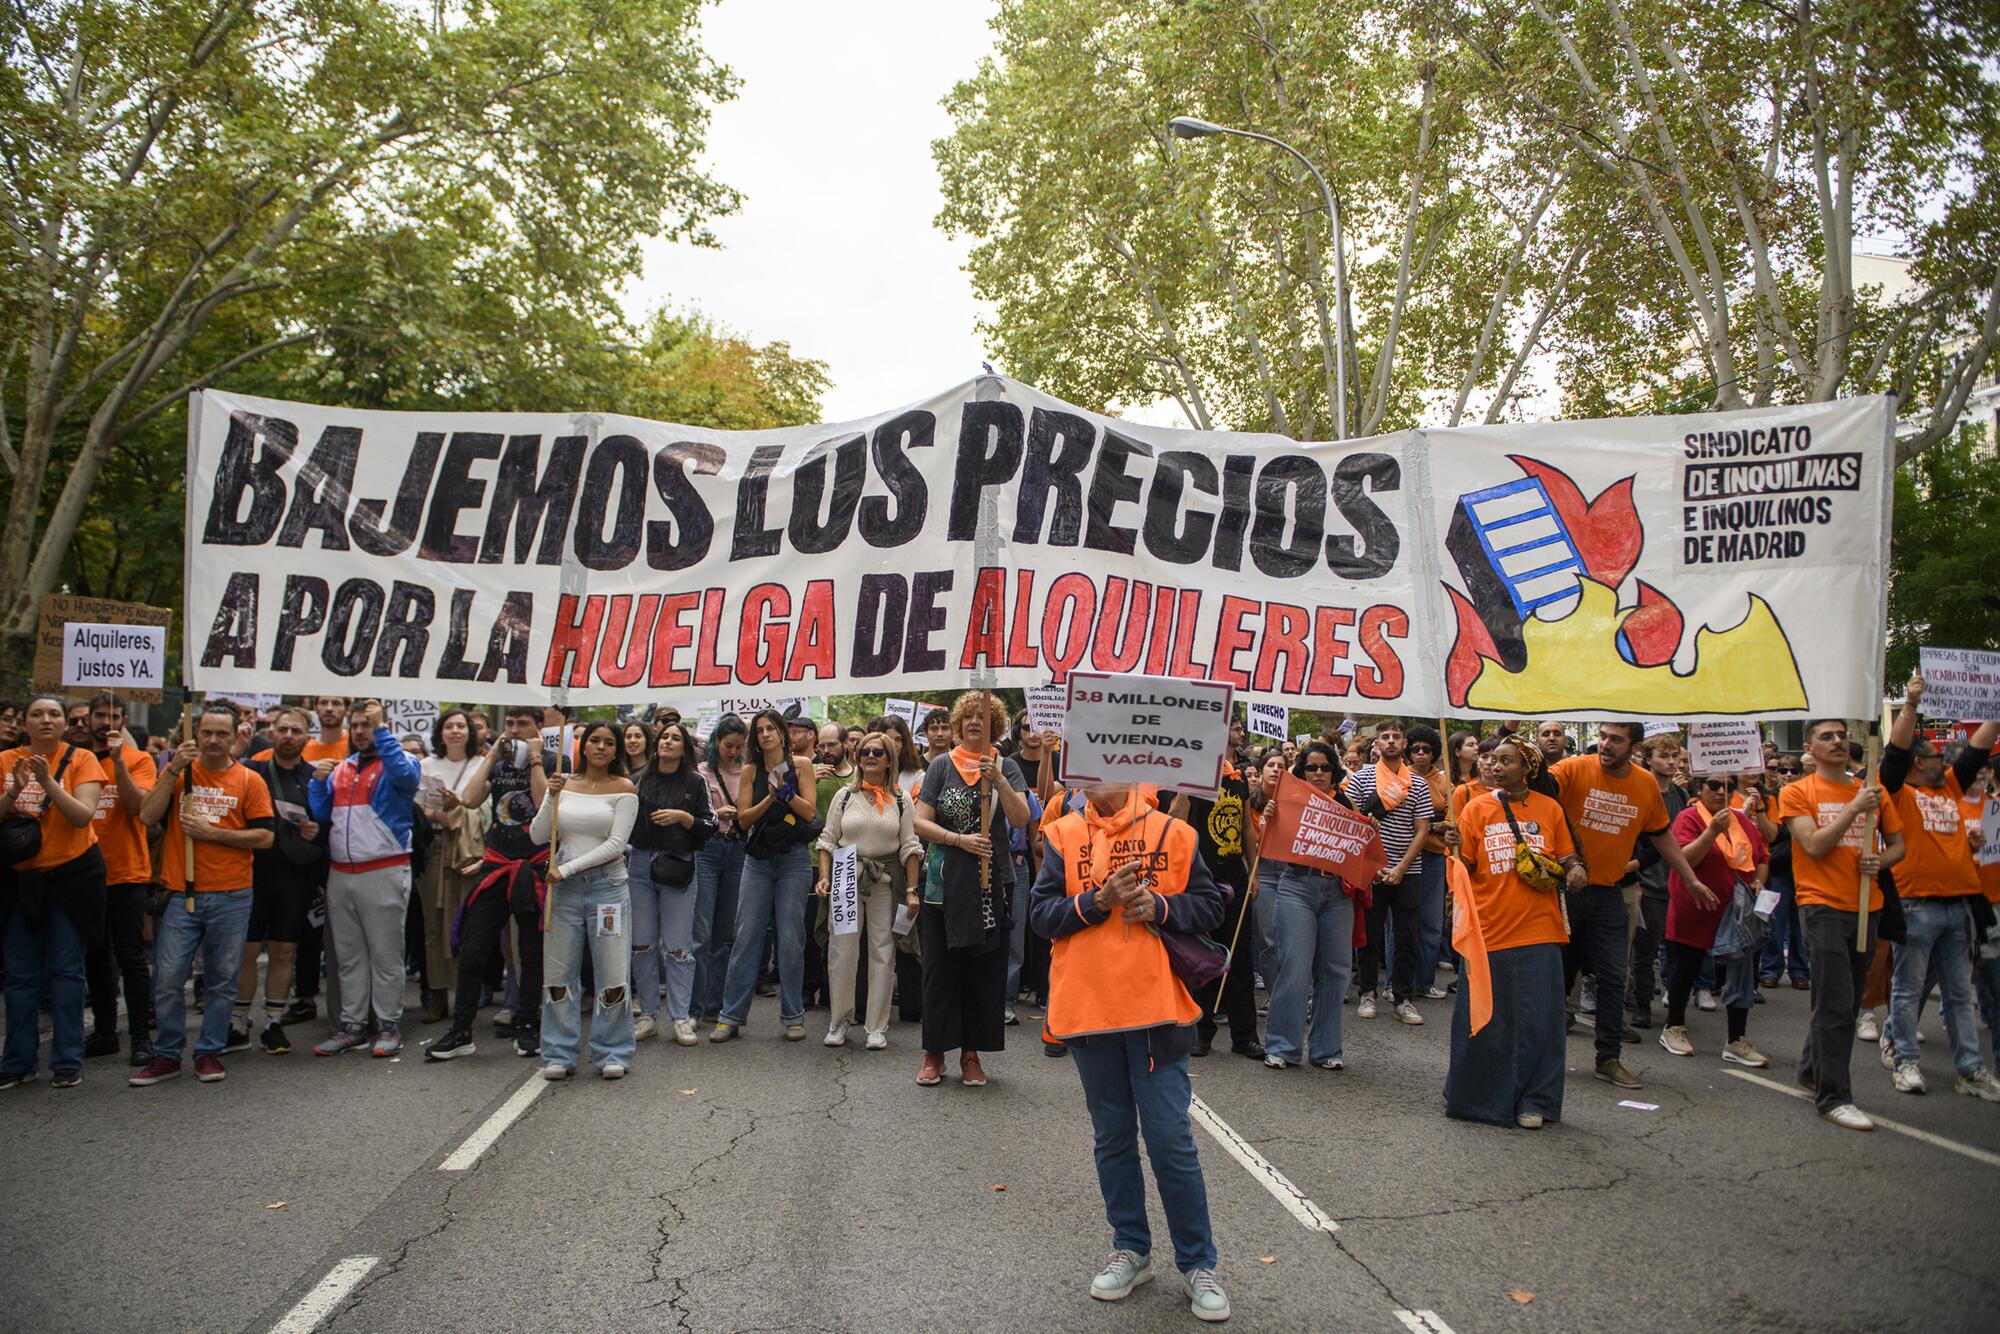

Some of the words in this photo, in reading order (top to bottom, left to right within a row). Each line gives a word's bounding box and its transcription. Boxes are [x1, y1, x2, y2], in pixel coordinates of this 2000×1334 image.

[1684, 426, 1811, 459] SINDICATO
[201, 409, 727, 571] BAJEMOS
[728, 410, 935, 562] LOS
[948, 400, 1401, 580] PRECIOS
[1688, 468, 1720, 498] DE
[1723, 457, 1858, 495] INQUILINAS
[1684, 506, 1697, 532] E
[1702, 496, 1833, 532] INQUILINOS
[1684, 535, 1714, 565] DE
[1716, 530, 1807, 563] MADRID
[53, 599, 69, 611] NO
[74, 628, 155, 653] Alquileres,
[200, 571, 260, 669] A
[270, 574, 436, 677] POR
[436, 588, 533, 684] LA
[542, 579, 834, 689] HUELGA
[850, 569, 954, 678] DE
[959, 566, 1410, 701] ALQUILERES
[76, 658, 125, 681] justos
[130, 658, 154, 679] YA.
[1074, 690, 1103, 703] 3,8
[1107, 693, 1223, 712] MILLONES
[1131, 714, 1161, 725] DE
[1253, 719, 1259, 731] A
[1086, 732, 1204, 750] VIVIENDAS
[1691, 730, 1756, 739] INMOBILIARIAS
[1102, 751, 1183, 768] VACÍAS
[1303, 808, 1319, 825] DE
[1318, 812, 1374, 842] INQUILINAS
[1292, 840, 1308, 855] DE
[1305, 844, 1346, 864] MADRID
[1296, 826, 1306, 838] E
[1304, 827, 1363, 856] INQUILINOS
[832, 861, 844, 902] Abusos
[845, 852, 856, 908] VIVIENDA
[833, 905, 844, 926] NO.
